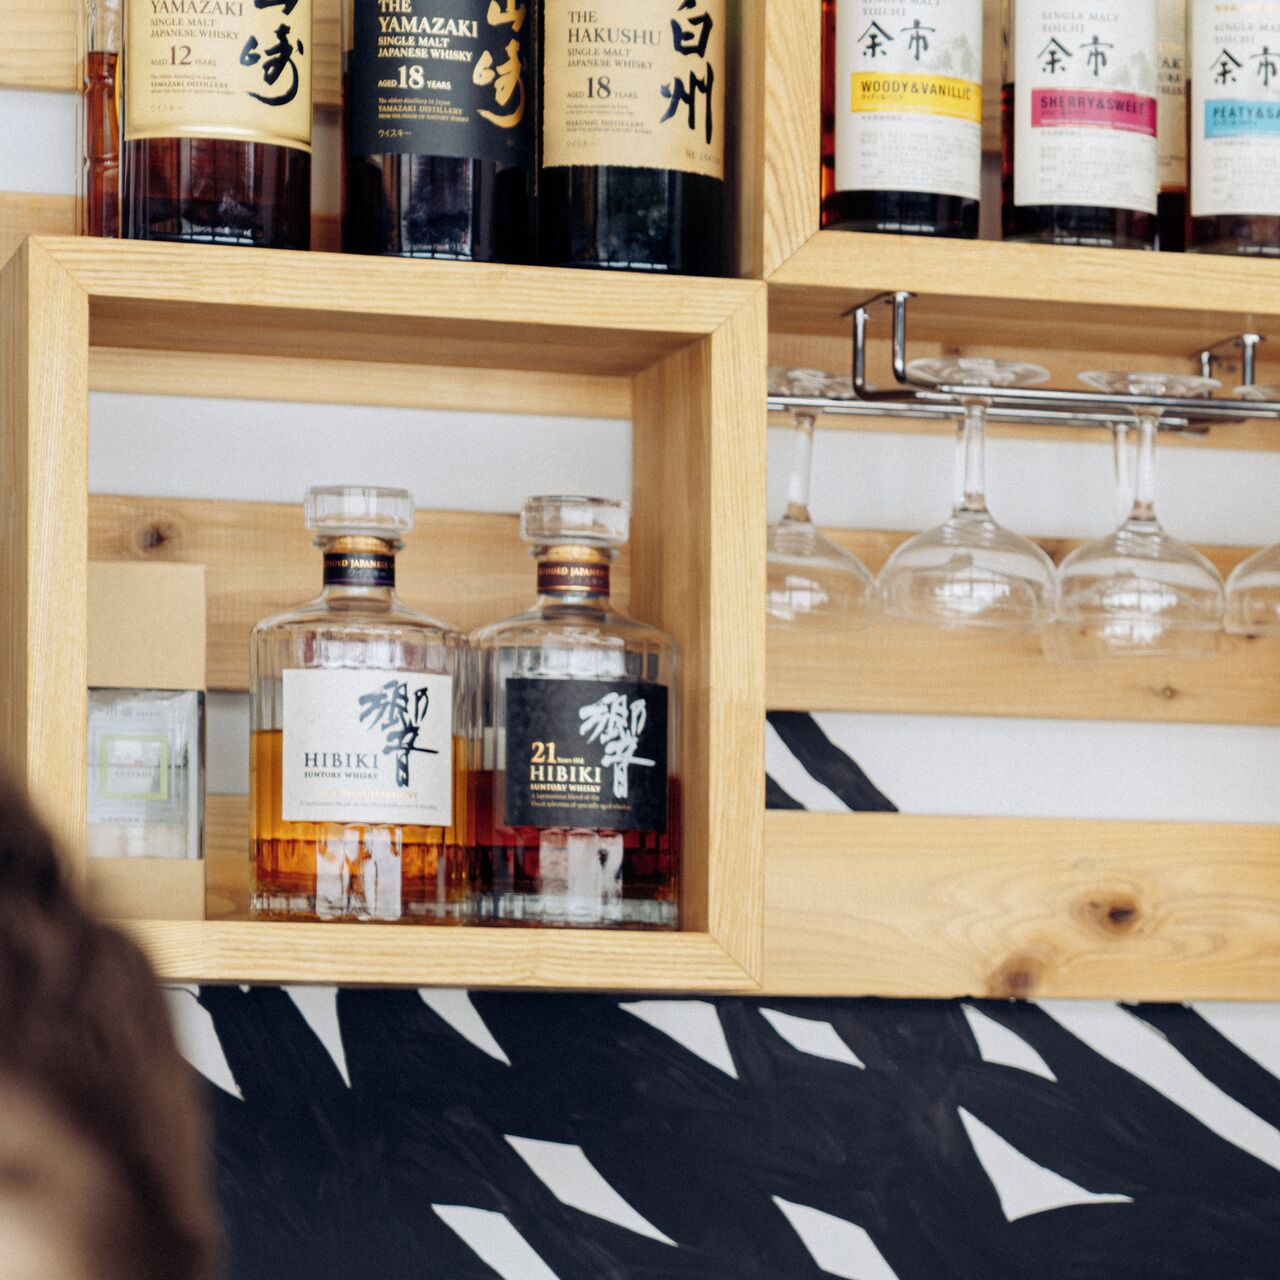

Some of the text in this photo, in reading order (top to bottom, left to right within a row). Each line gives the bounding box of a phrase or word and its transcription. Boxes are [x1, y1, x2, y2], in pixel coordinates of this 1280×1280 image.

[151, 0, 243, 16] YAMAZAKI
[378, 0, 411, 13] THE
[863, 8, 905, 16] YOICHI
[151, 18, 215, 27] SINGLE MALT
[568, 11, 597, 23] THE
[151, 29, 240, 40] JAPANESE WHISKY
[378, 16, 478, 38] YAMAZAKI
[378, 36, 449, 47] SINGLE MALT
[568, 28, 662, 46] HAKUSHU
[857, 20, 936, 60] 余市
[170, 45, 192, 65] 12
[195, 58, 216, 66] YEARS
[378, 48, 473, 62] JAPANESE WHISKY
[567, 48, 630, 57] SINGLE MALT
[1037, 35, 1114, 76] 余市
[567, 59, 653, 70] JAPANESE WHISKY
[378, 65, 451, 90] AGED 18 YEARS
[587, 76, 611, 99] 18
[378, 105, 416, 113] YAMAZAKI
[304, 752, 379, 769] HIBIKI
[531, 742, 556, 764] 21
[530, 765, 602, 783] HIBIKI
[569, 784, 601, 792] WHISKY
